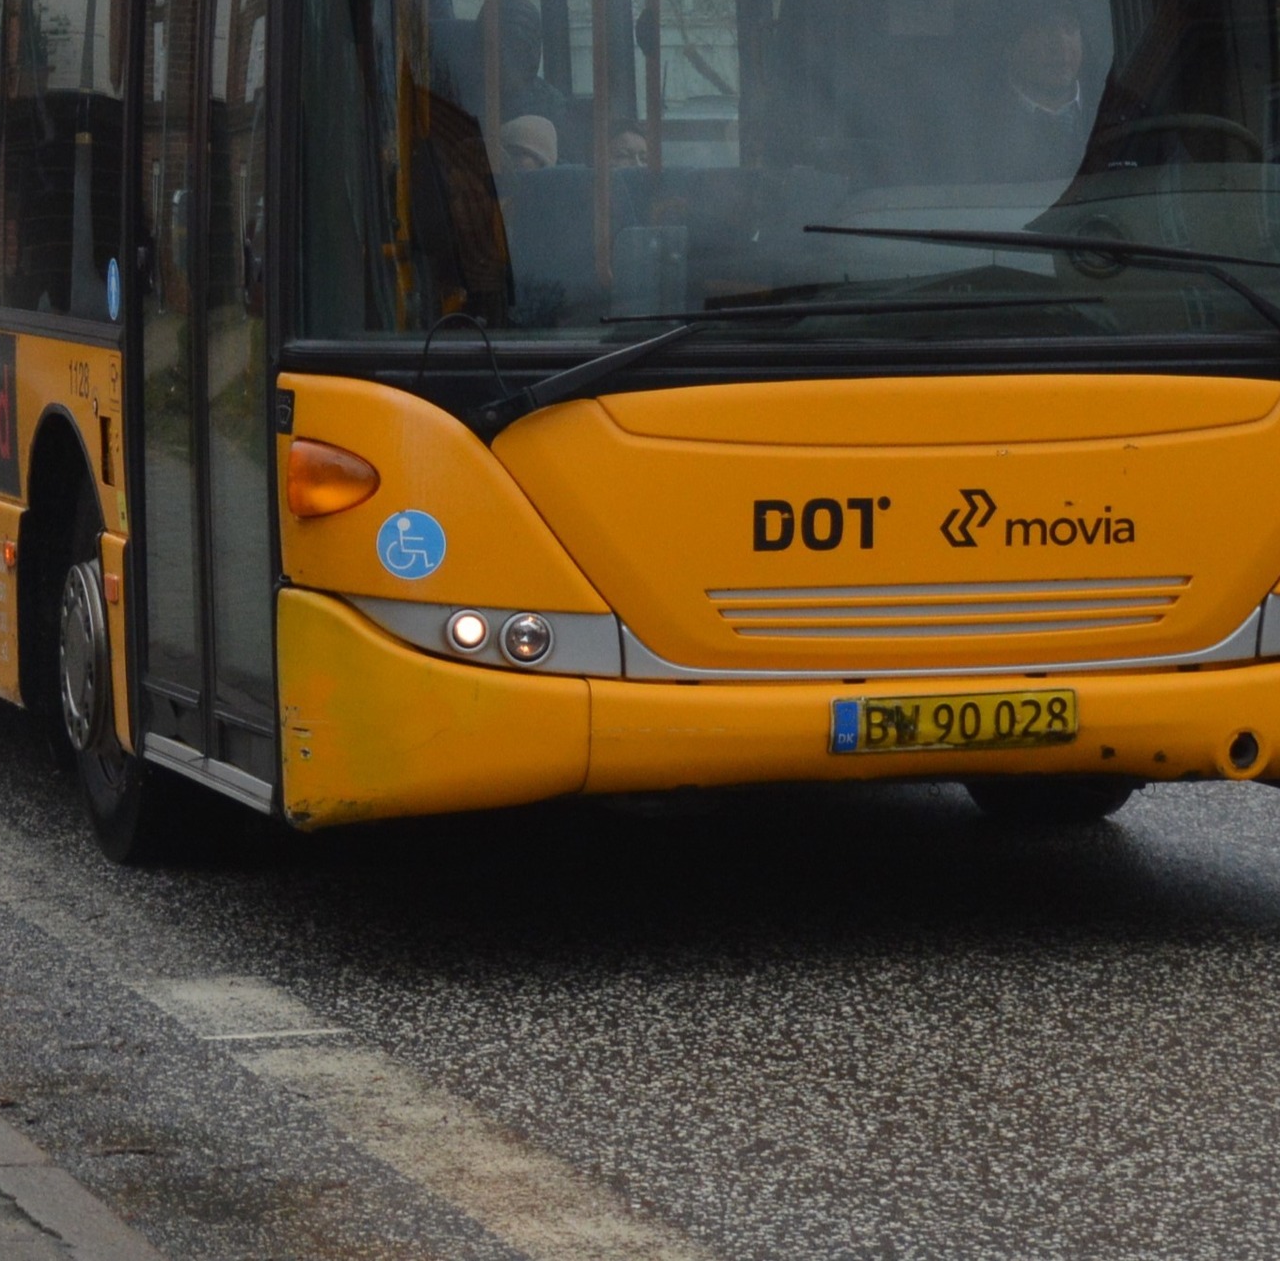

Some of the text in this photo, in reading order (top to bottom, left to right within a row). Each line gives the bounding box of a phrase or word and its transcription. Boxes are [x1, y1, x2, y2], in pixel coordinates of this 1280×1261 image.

[69, 358, 90, 400] 1128
[752, 496, 878, 552] DOT
[1004, 505, 1136, 547] movia
[837, 732, 855, 745] DK
[932, 701, 982, 742] 90
[994, 696, 1069, 739] 028
